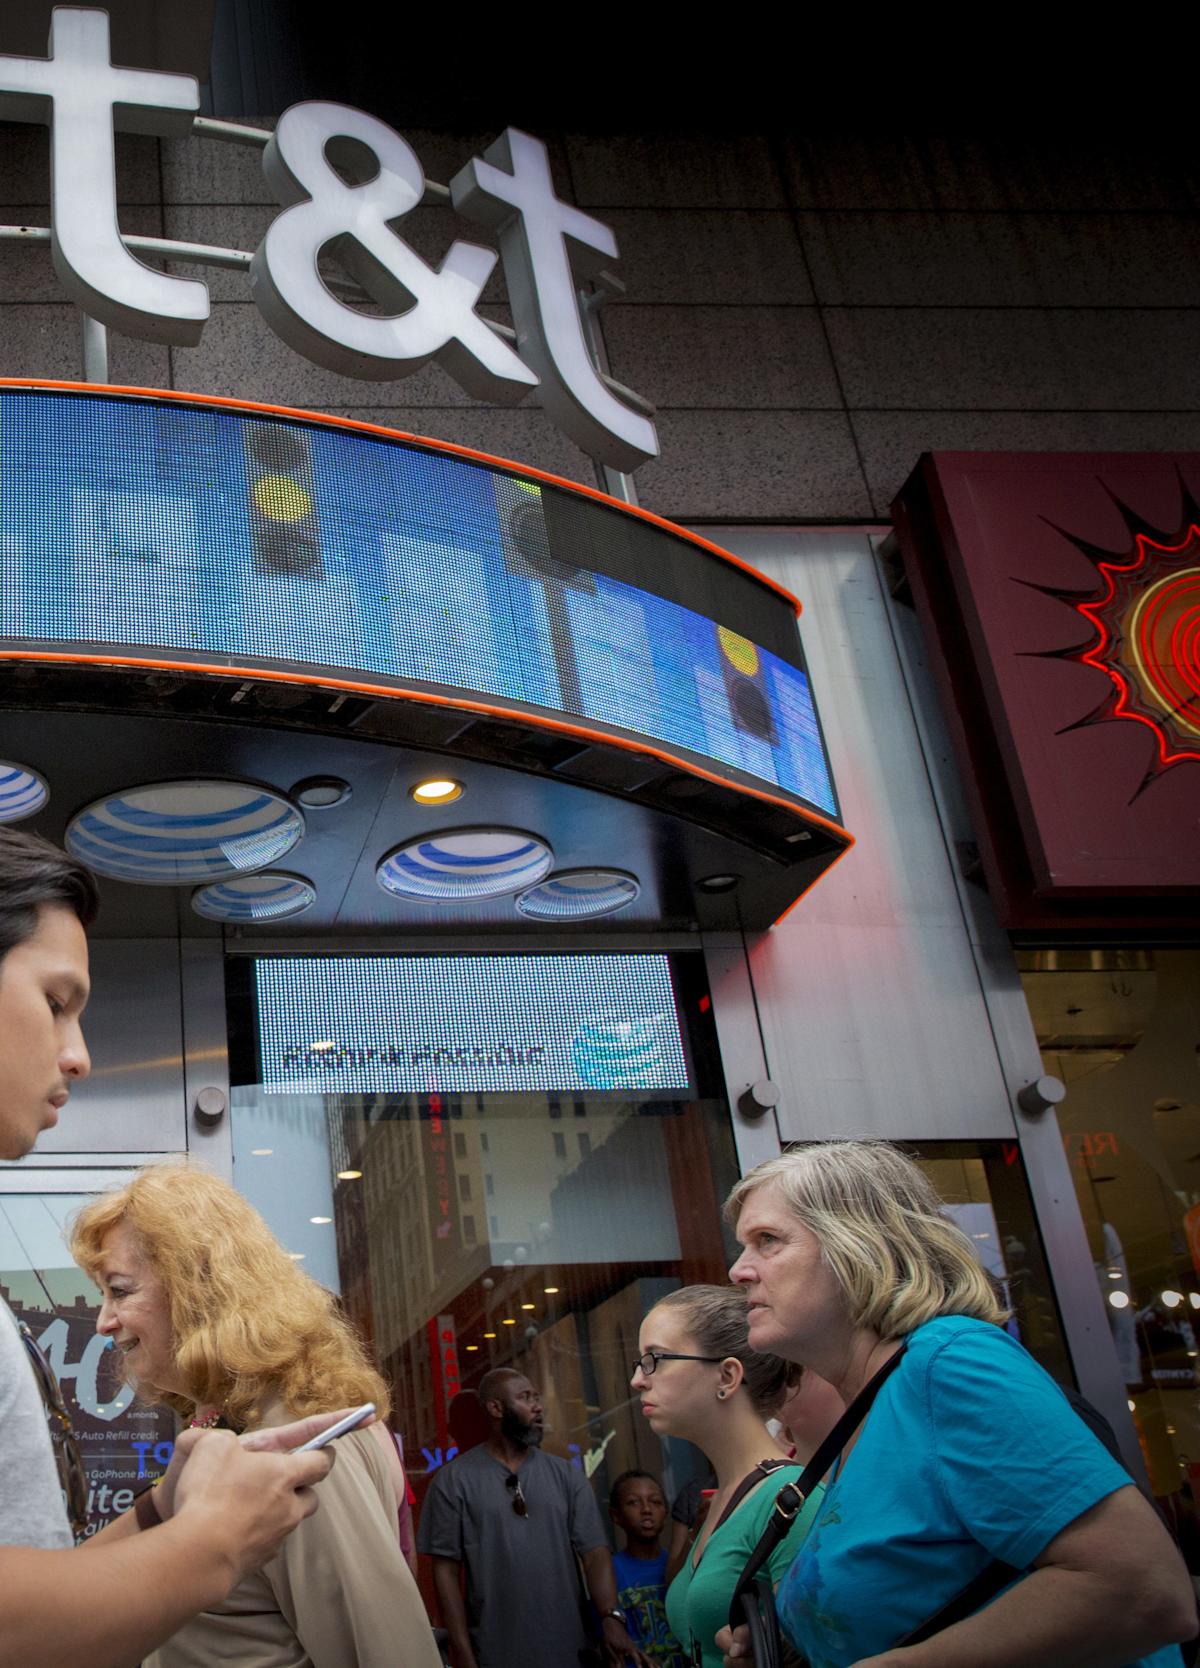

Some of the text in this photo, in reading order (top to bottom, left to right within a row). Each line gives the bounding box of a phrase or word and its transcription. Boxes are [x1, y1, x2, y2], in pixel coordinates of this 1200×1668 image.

[81, 1431, 104, 1440] Auto
[106, 1431, 129, 1440] Refill
[130, 1431, 159, 1440] credit
[90, 1470, 136, 1479] GoPhone
[137, 1470, 160, 1481] plan
